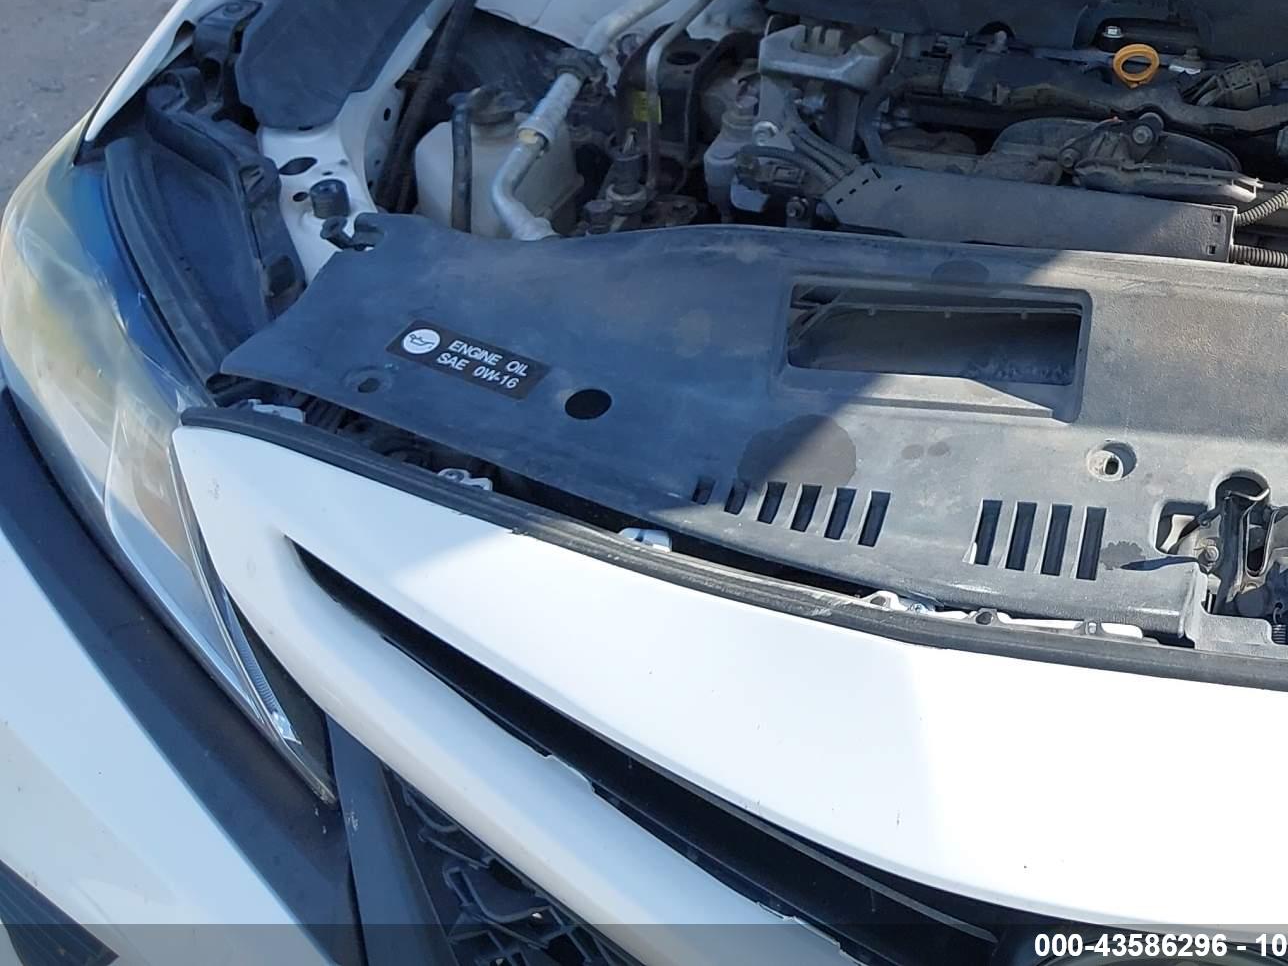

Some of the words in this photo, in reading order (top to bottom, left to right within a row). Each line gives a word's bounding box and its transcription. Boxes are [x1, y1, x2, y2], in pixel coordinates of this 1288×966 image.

[436, 352, 470, 371] SAE
[472, 366, 520, 389] 0W-16
[448, 340, 502, 365] ENGINE
[505, 360, 528, 376] OIL
